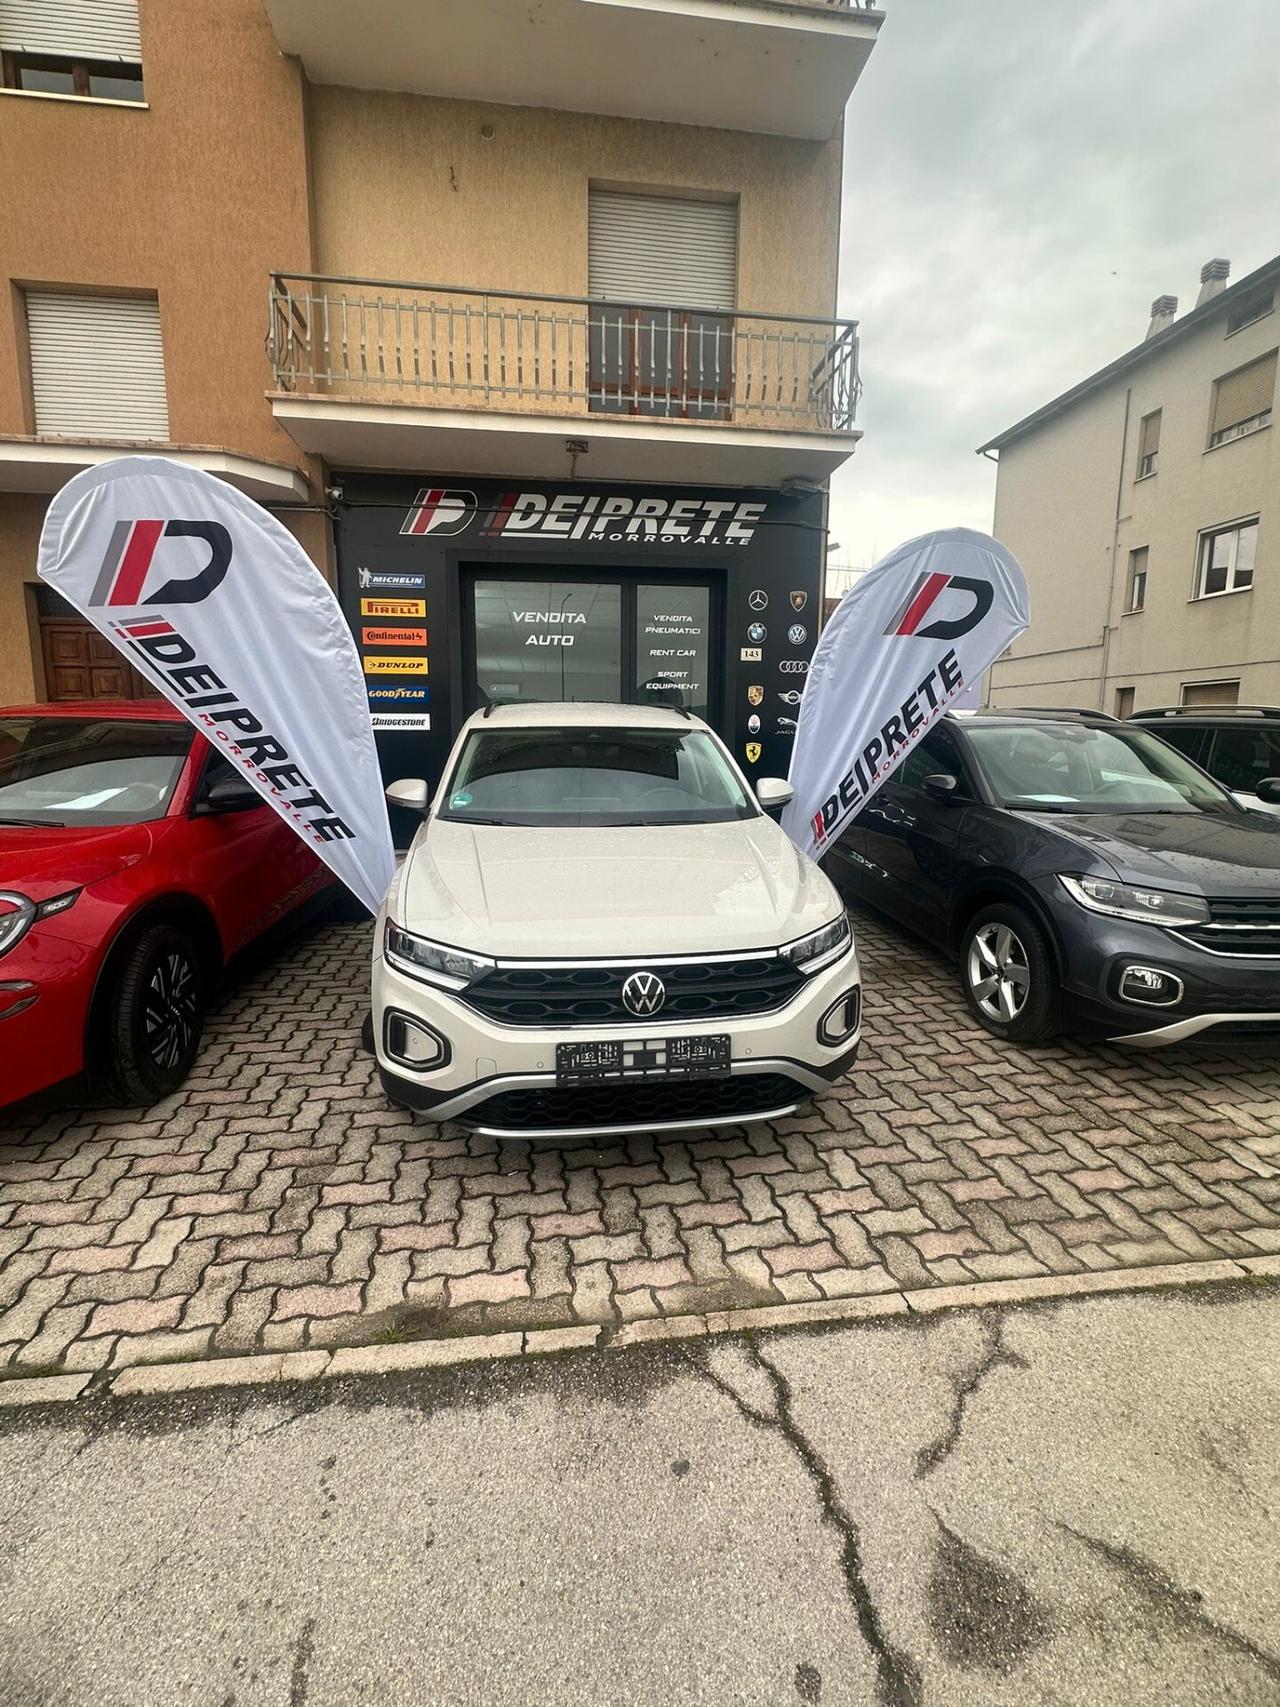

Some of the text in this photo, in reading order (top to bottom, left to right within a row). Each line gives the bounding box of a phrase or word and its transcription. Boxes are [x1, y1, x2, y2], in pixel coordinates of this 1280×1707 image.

[588, 532, 752, 547] MORROVALLE
[372, 576, 423, 585] MICHELIN
[367, 601, 419, 615] PIRELLI
[512, 611, 587, 624] VENDITA
[653, 614, 693, 623] VENDITA
[366, 630, 415, 641] Continental
[645, 627, 701, 635] PNEUMATICI
[525, 635, 575, 646] AUTO
[649, 649, 696, 657] RENT CAR
[744, 650, 759, 658] 143
[377, 662, 424, 670] DUNLOP
[368, 687, 425, 699] GOODYEAR
[371, 717, 427, 727] BRIDGESTONE
[871, 679, 966, 785] MORROVALLE
[198, 713, 326, 844] MORROVALLE
